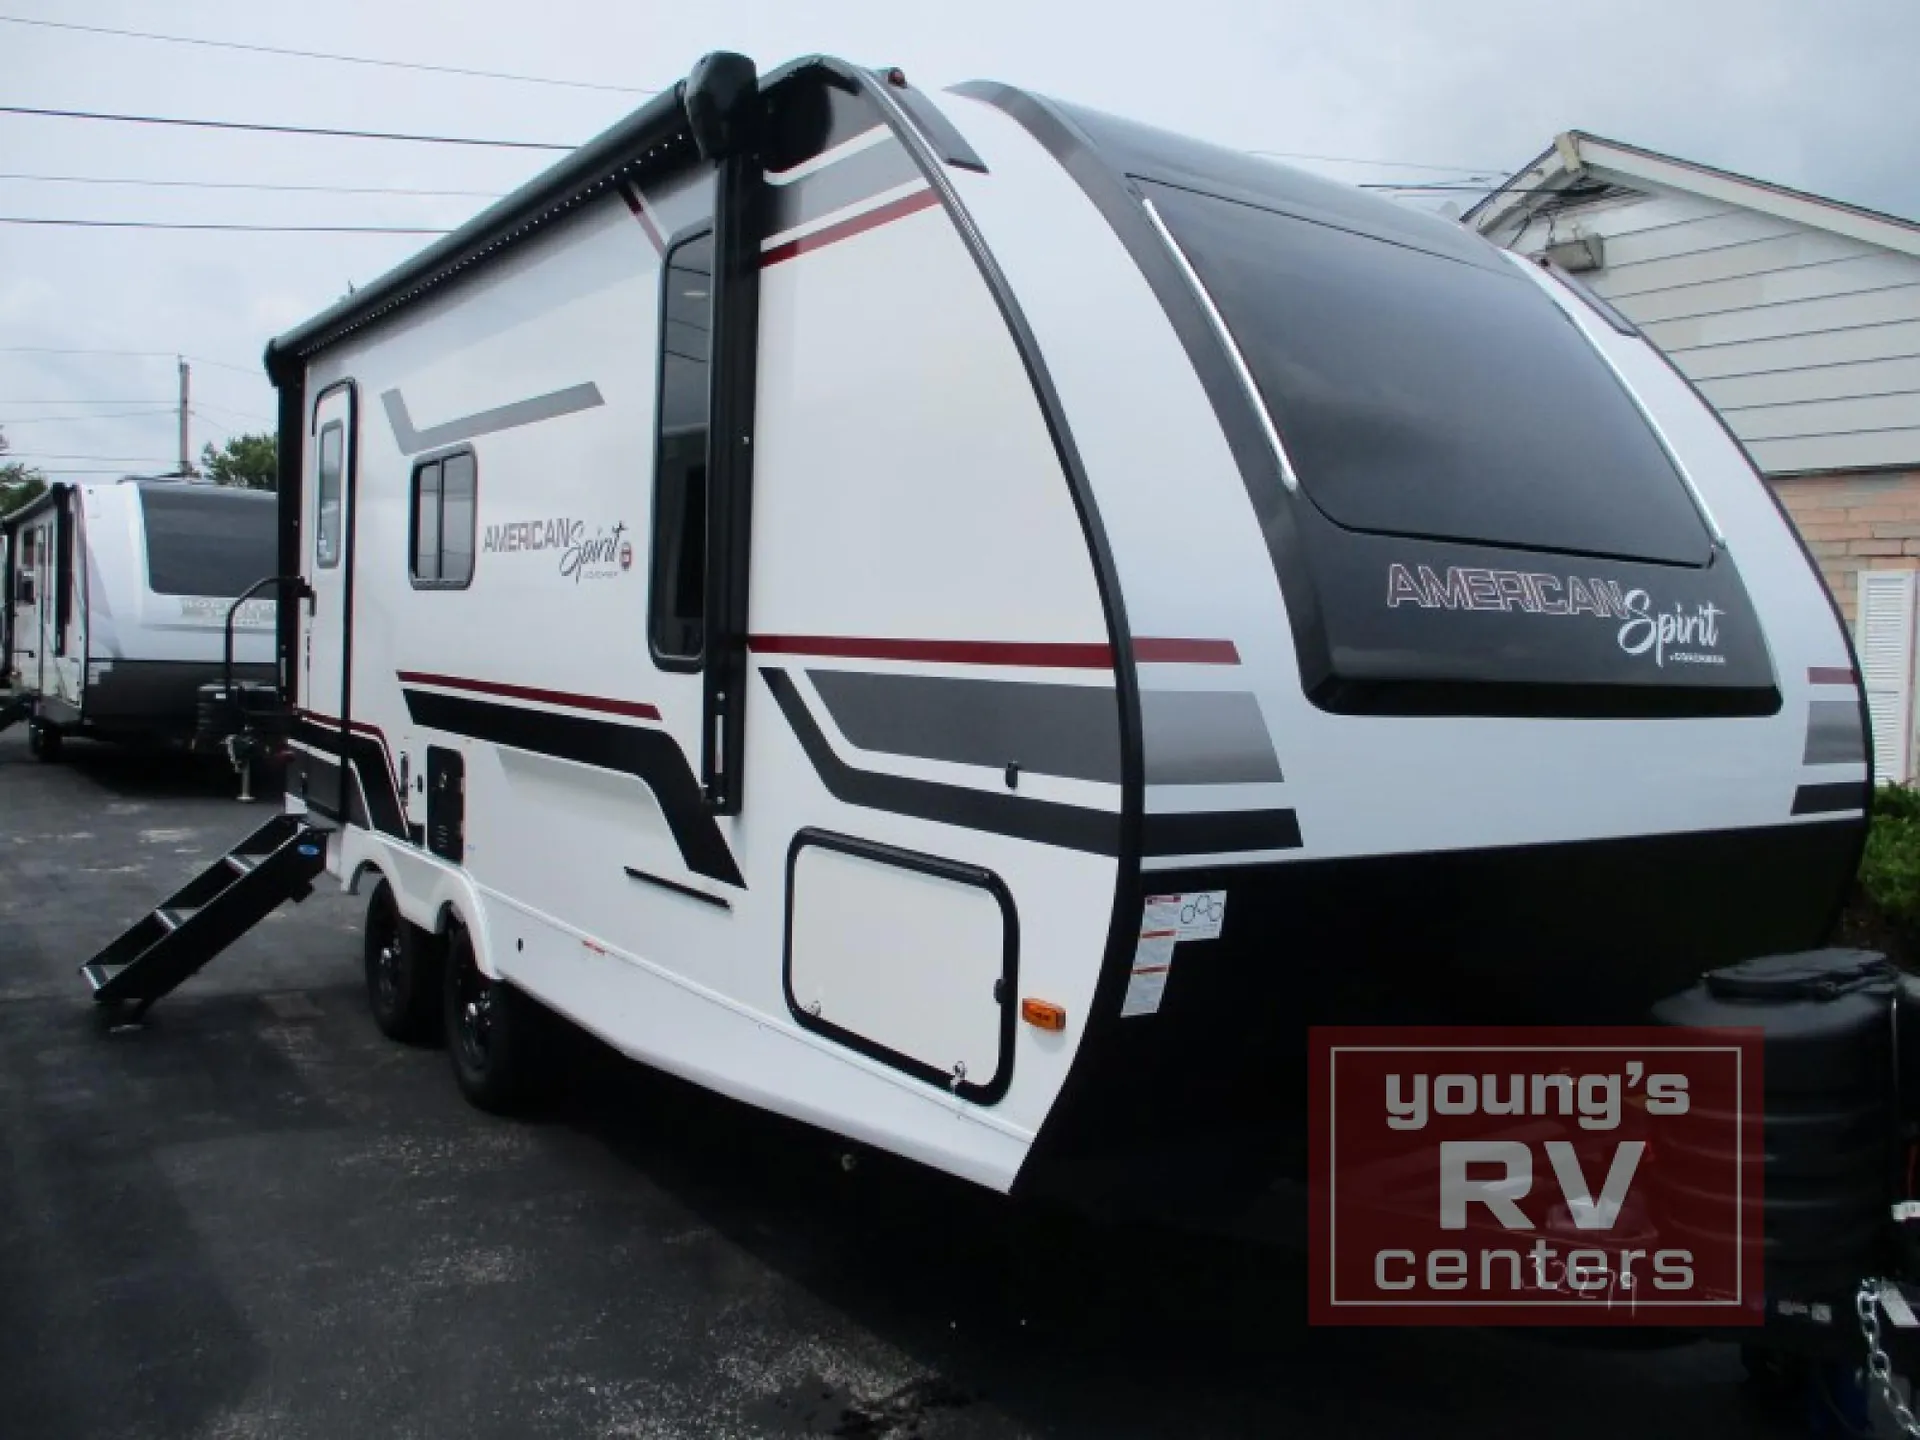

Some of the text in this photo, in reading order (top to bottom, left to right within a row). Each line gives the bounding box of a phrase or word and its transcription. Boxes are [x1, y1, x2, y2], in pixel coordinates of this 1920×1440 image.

[484, 518, 570, 553] AMERICAN
[1386, 563, 1726, 667] AMERICAN Spirit
